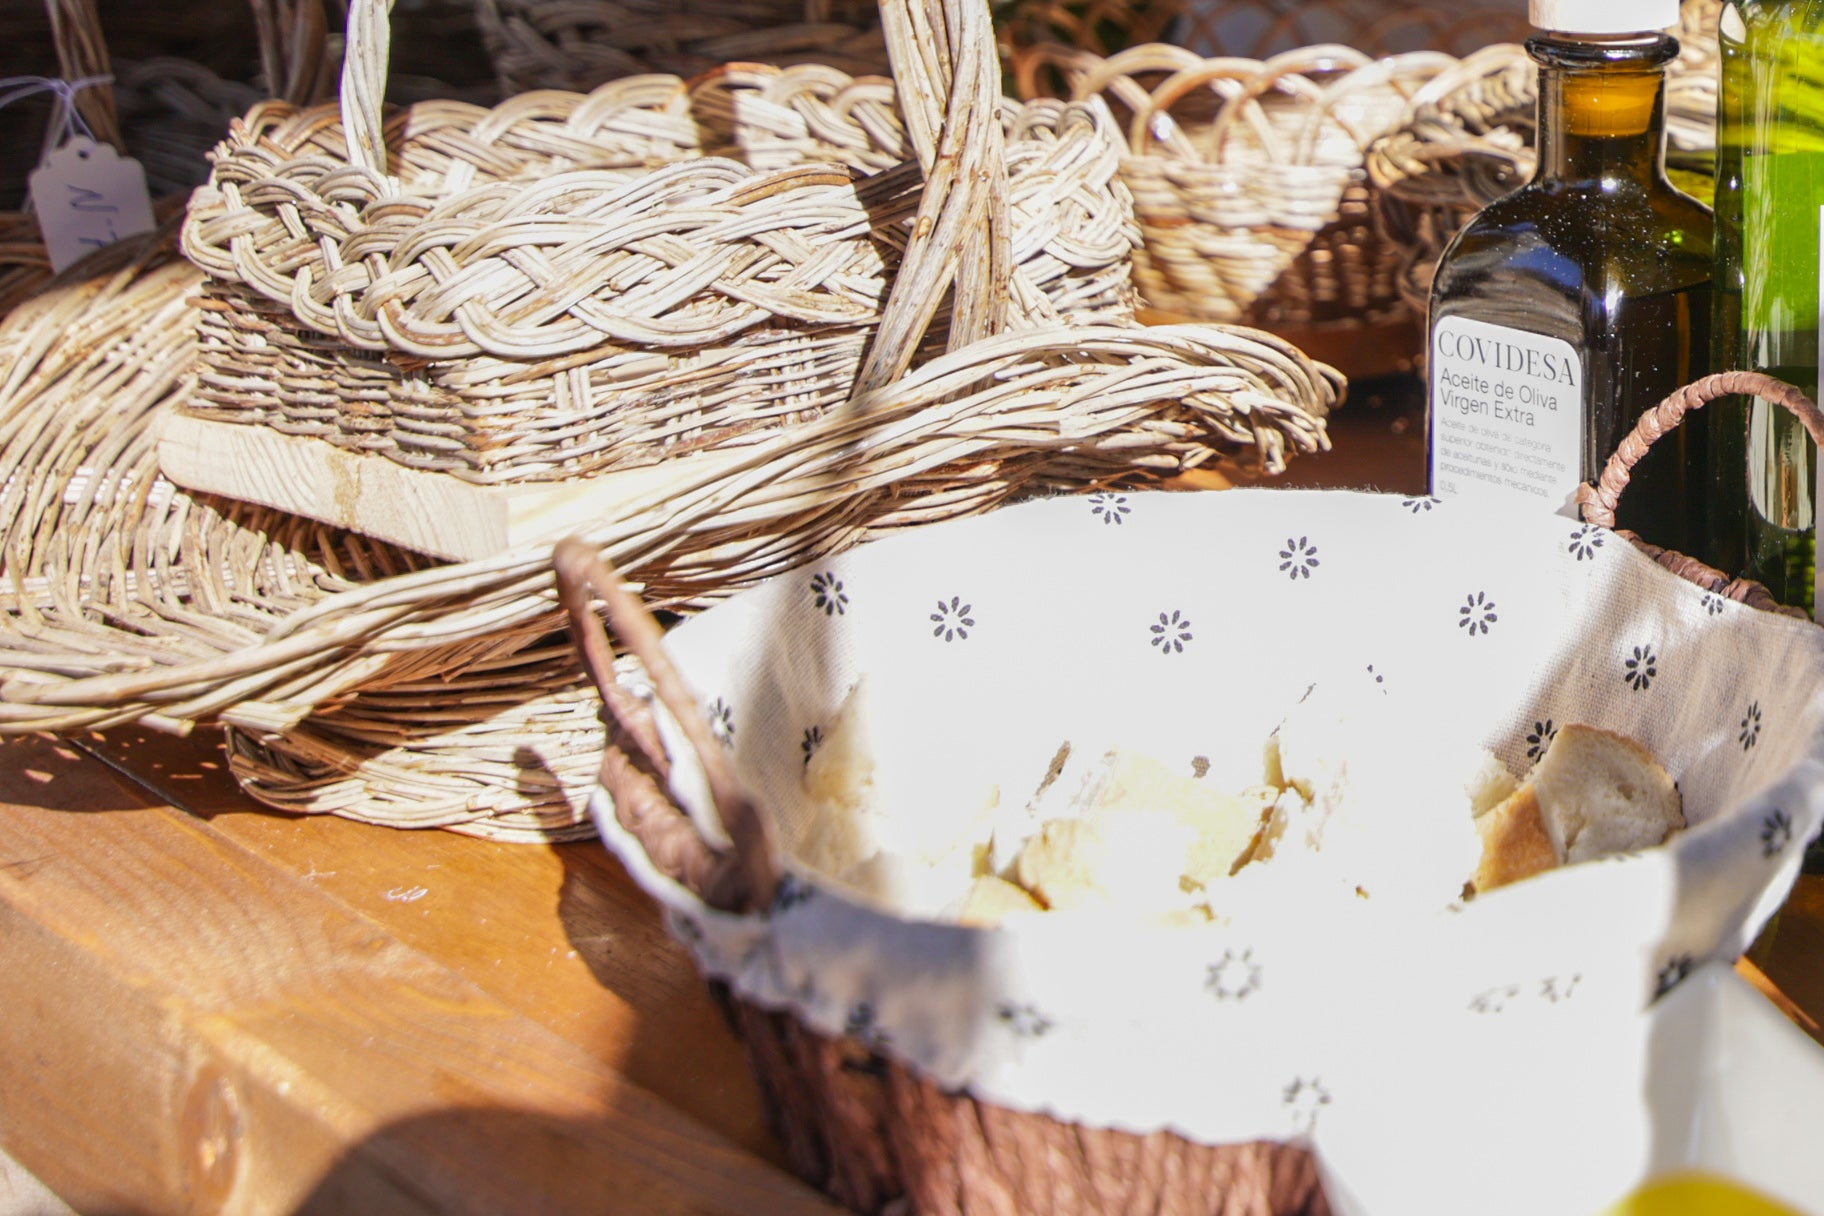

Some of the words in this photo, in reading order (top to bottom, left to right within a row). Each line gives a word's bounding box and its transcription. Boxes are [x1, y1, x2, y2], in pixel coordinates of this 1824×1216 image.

[1438, 330, 1576, 387] COVIDESA
[1440, 367, 1489, 394] Aceite
[1494, 380, 1514, 400] de
[1519, 384, 1558, 412] Oliva
[1440, 388, 1489, 416] Virgen
[1494, 400, 1535, 427] Extra
